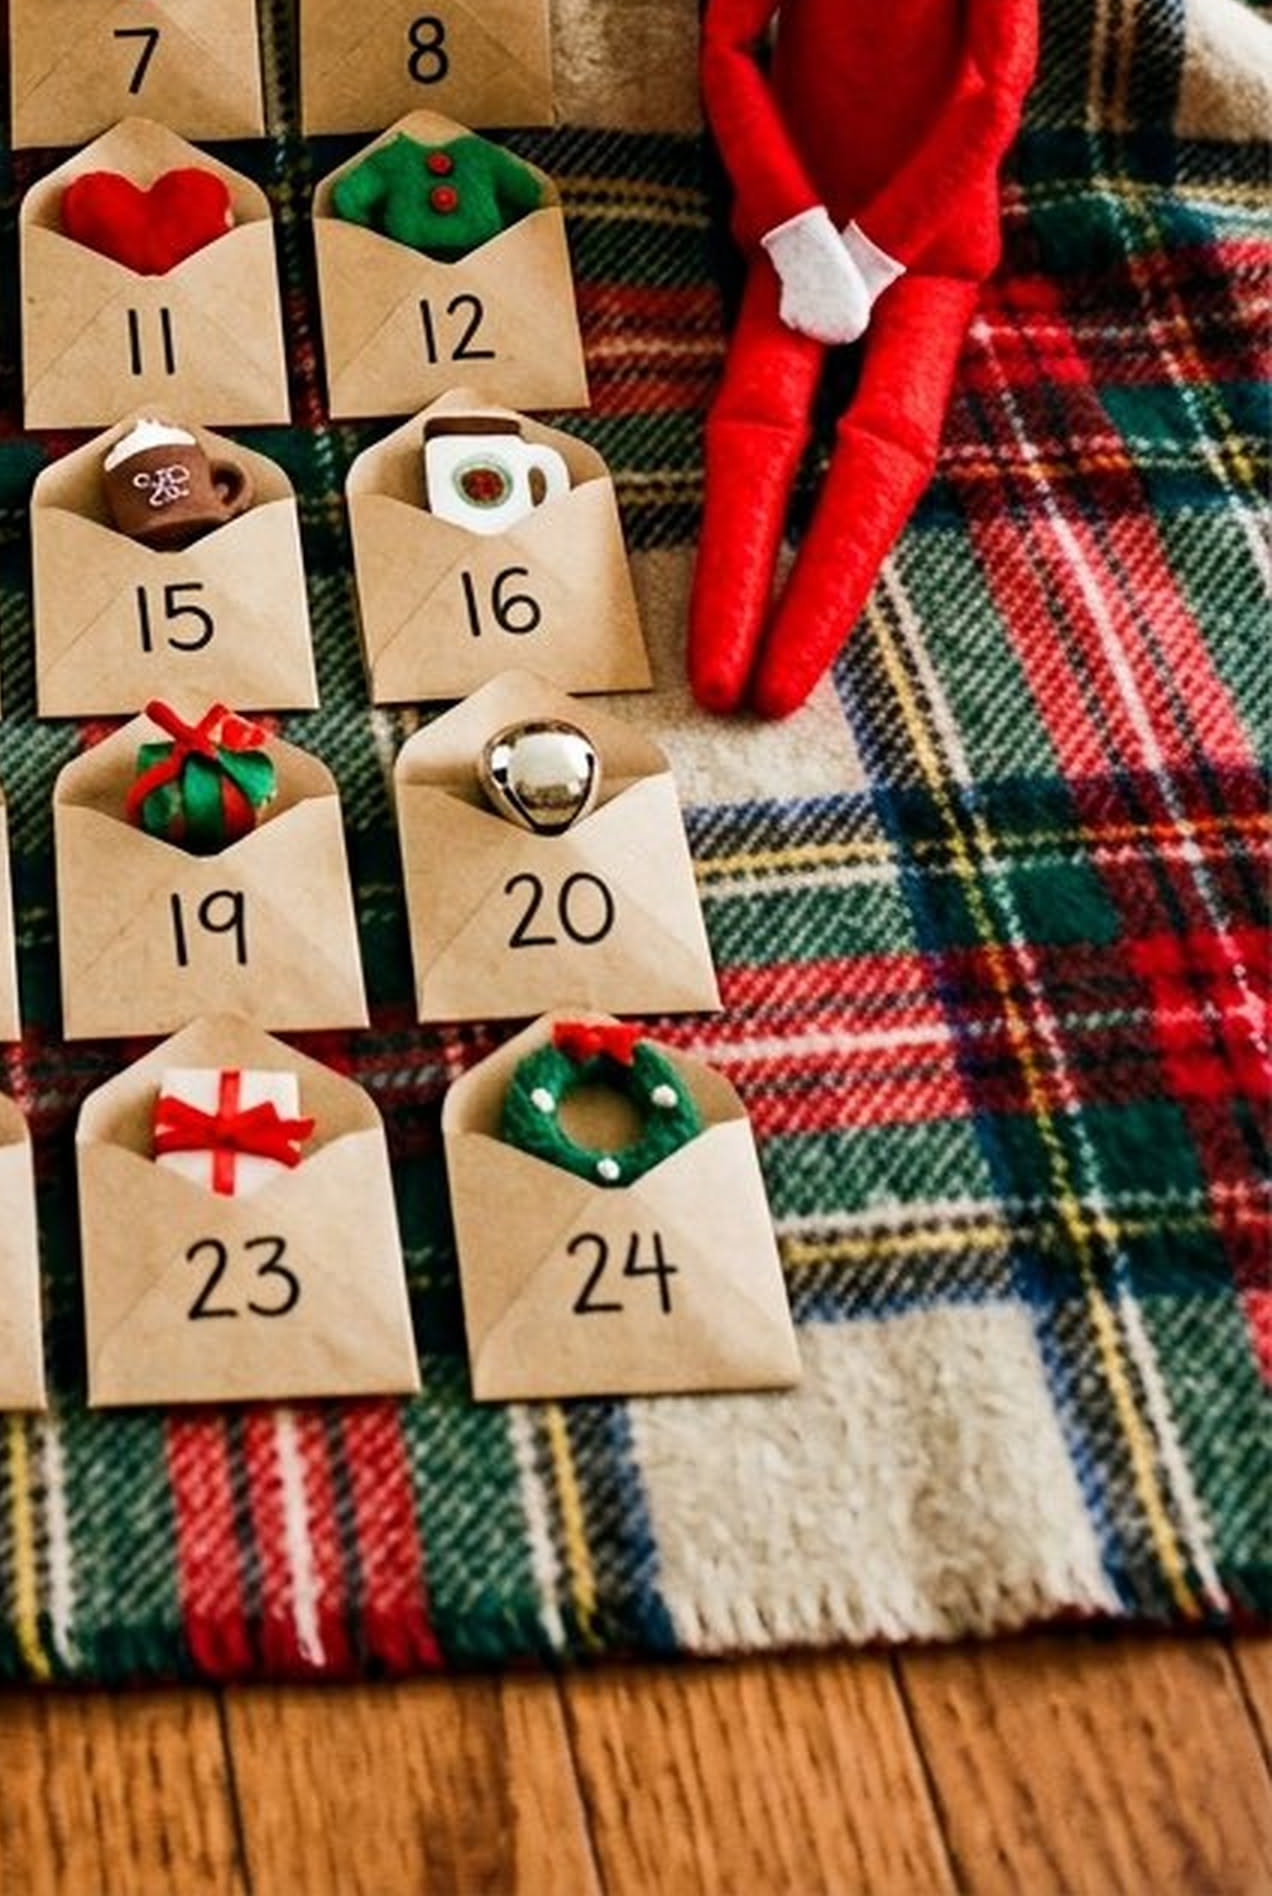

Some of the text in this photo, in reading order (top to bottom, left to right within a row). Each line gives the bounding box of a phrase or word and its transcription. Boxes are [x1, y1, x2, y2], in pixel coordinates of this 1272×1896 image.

[112, 26, 161, 96] 7
[406, 14, 452, 87] 8
[127, 306, 176, 377] 11
[418, 293, 497, 365] 12
[136, 582, 215, 654] 15
[460, 566, 542, 638] 16
[170, 889, 248, 968] 19
[503, 871, 615, 950] 20
[185, 1235, 301, 1322] 23
[566, 1232, 678, 1316] 24
